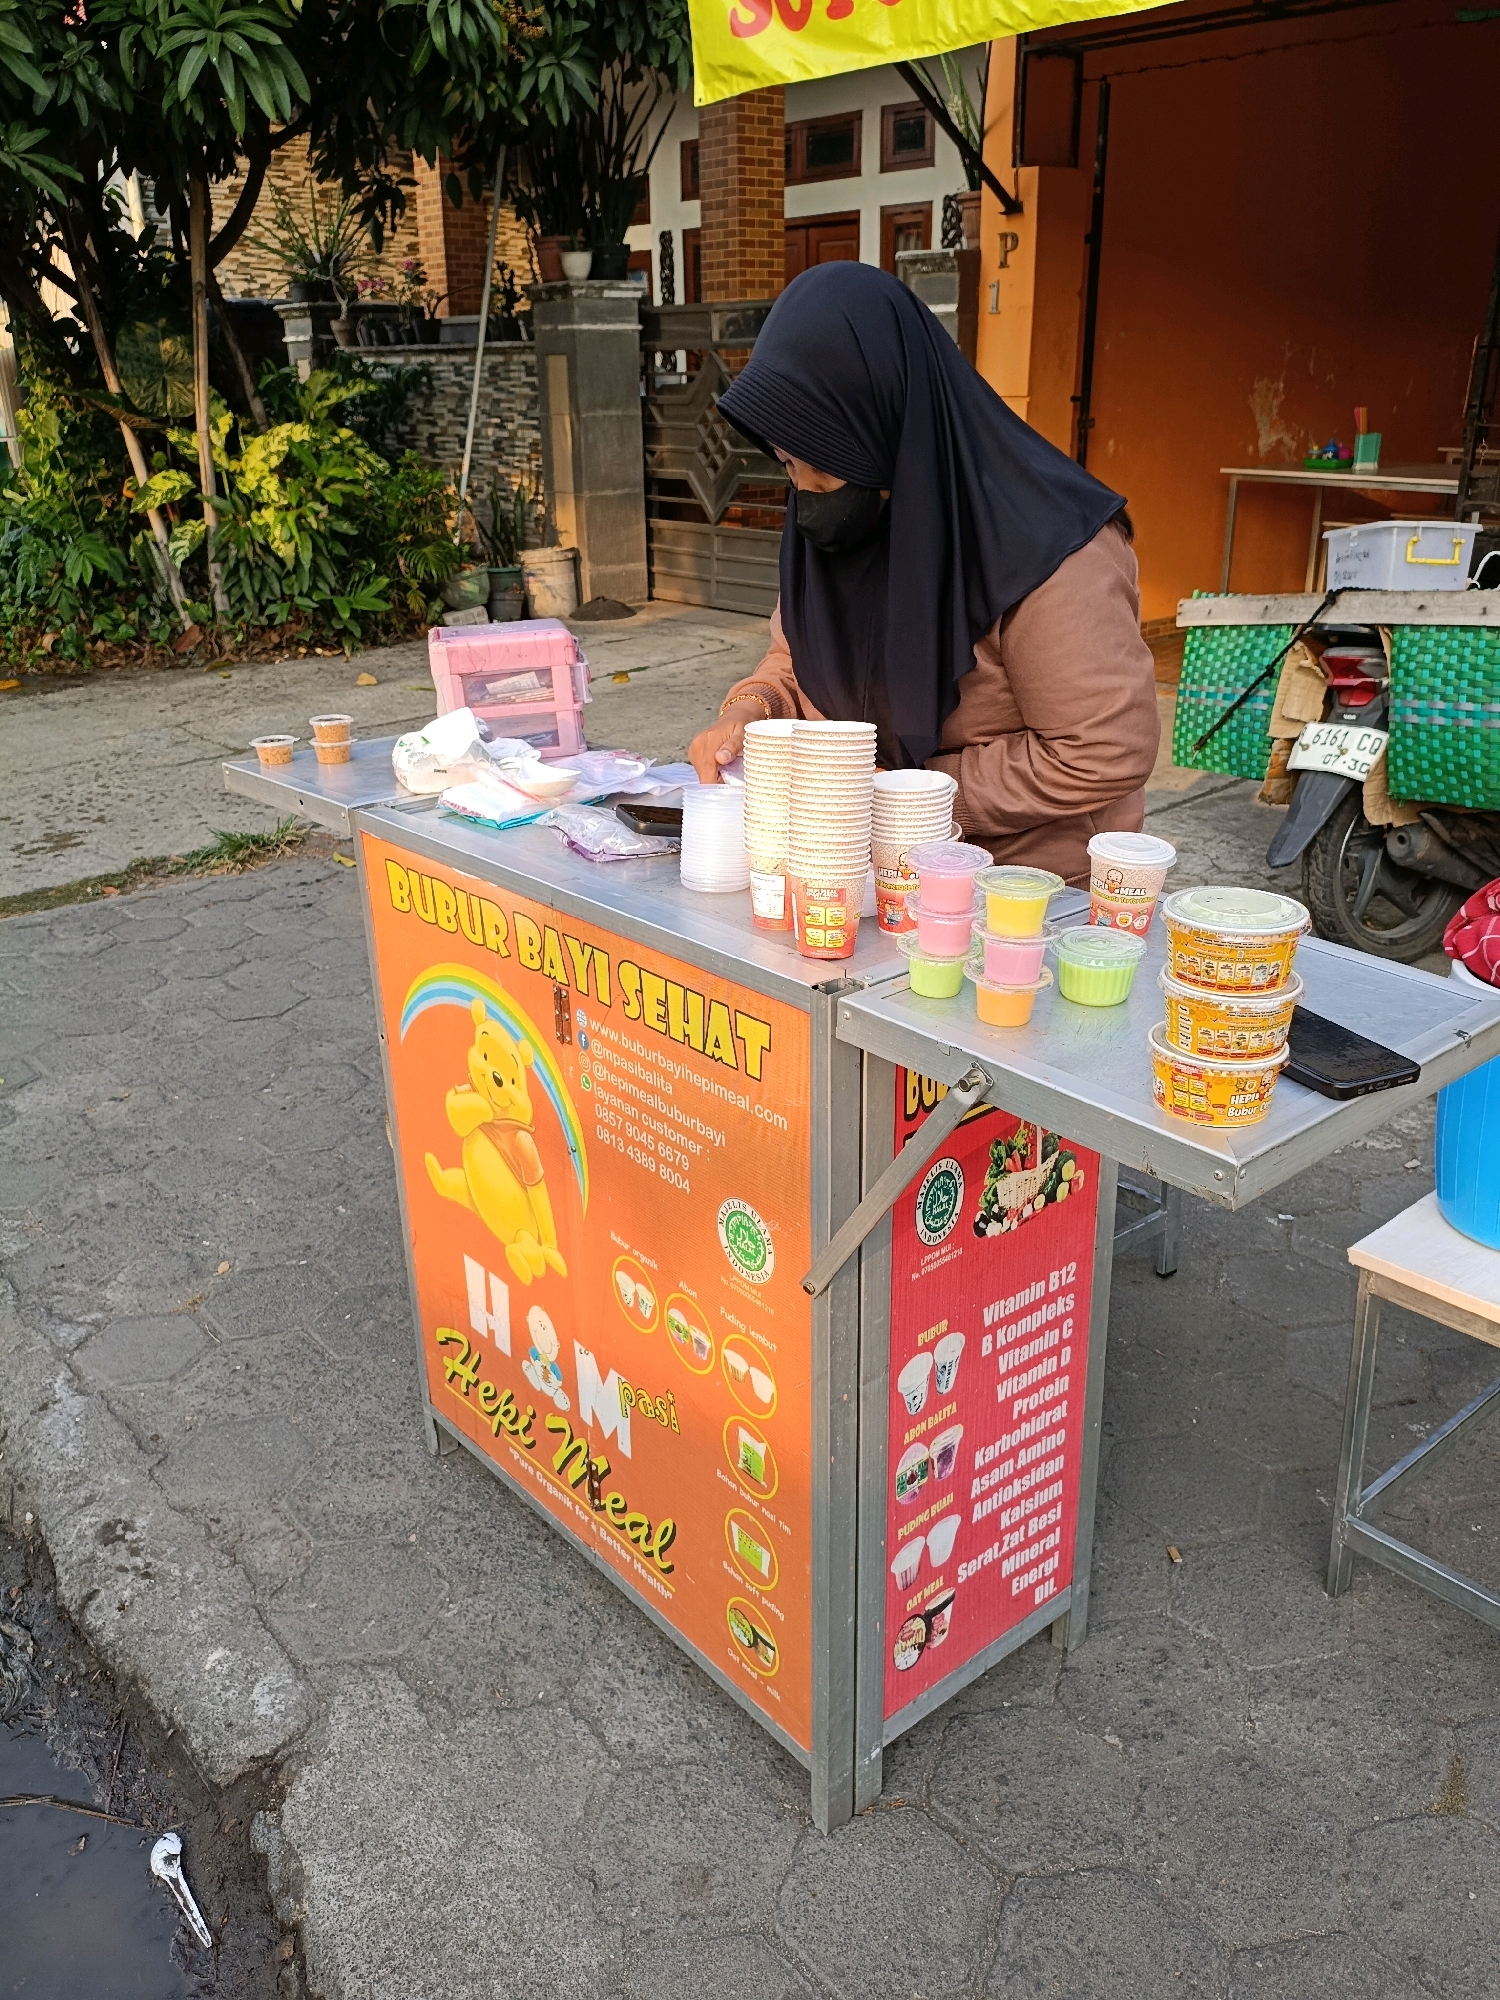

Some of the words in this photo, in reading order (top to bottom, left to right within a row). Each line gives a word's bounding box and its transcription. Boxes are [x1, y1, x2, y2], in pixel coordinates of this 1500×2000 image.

[998, 232, 1019, 268] P
[1312, 728, 1349, 748] 6161
[385, 858, 511, 960] BUBUR
[513, 911, 611, 1008] BAYI
[618, 960, 771, 1081] SEHAT
[590, 1019, 788, 1131] www.buburbayihepimeal.com
[591, 1038, 673, 1095] @mpasibalita
[593, 1061, 726, 1147] @hepimealbuburbayi
[593, 1081, 638, 1120] layanan
[642, 1113, 702, 1156] customer
[1228, 1105, 1258, 1117] Bubur
[595, 1103, 622, 1130] 0857
[626, 1123, 654, 1150] 9045
[658, 1141, 689, 1170] 6679
[596, 1124, 624, 1153] 0813
[627, 1147, 655, 1172] 4389
[660, 1163, 690, 1194] 8004
[463, 1253, 512, 1357] H
[983, 1280, 1045, 1327] Vitamin
[1049, 1261, 1076, 1293] B12
[917, 1319, 949, 1347] BUBUR
[981, 1334, 992, 1358] B
[996, 1293, 1075, 1350] Kompleks
[998, 1329, 1060, 1375] Vitamin
[1062, 1317, 1074, 1338] C
[996, 1356, 1057, 1403] Vitamin
[1060, 1345, 1071, 1367] D
[1012, 1374, 1070, 1420] Protein
[903, 1420, 926, 1446] ABON
[928, 1401, 957, 1431] BALITA
[974, 1399, 1067, 1470] Karbohidrat
[970, 1459, 1014, 1499] Asam
[1017, 1428, 1066, 1468] Amino
[971, 1455, 1064, 1524] Antioksidan
[536, 1471, 573, 1510] Organik
[575, 1505, 589, 1523] for
[600, 1526, 631, 1563] Better
[897, 1508, 930, 1541] PUDING
[931, 1492, 954, 1520] BUAH
[1000, 1479, 1062, 1530] Kalsium
[1028, 1502, 1062, 1538] Besi
[1001, 1526, 1060, 1579] Mineral
[1011, 1551, 1059, 1596] Energi
[906, 1591, 923, 1612] OAT
[923, 1575, 944, 1602] MEAL
